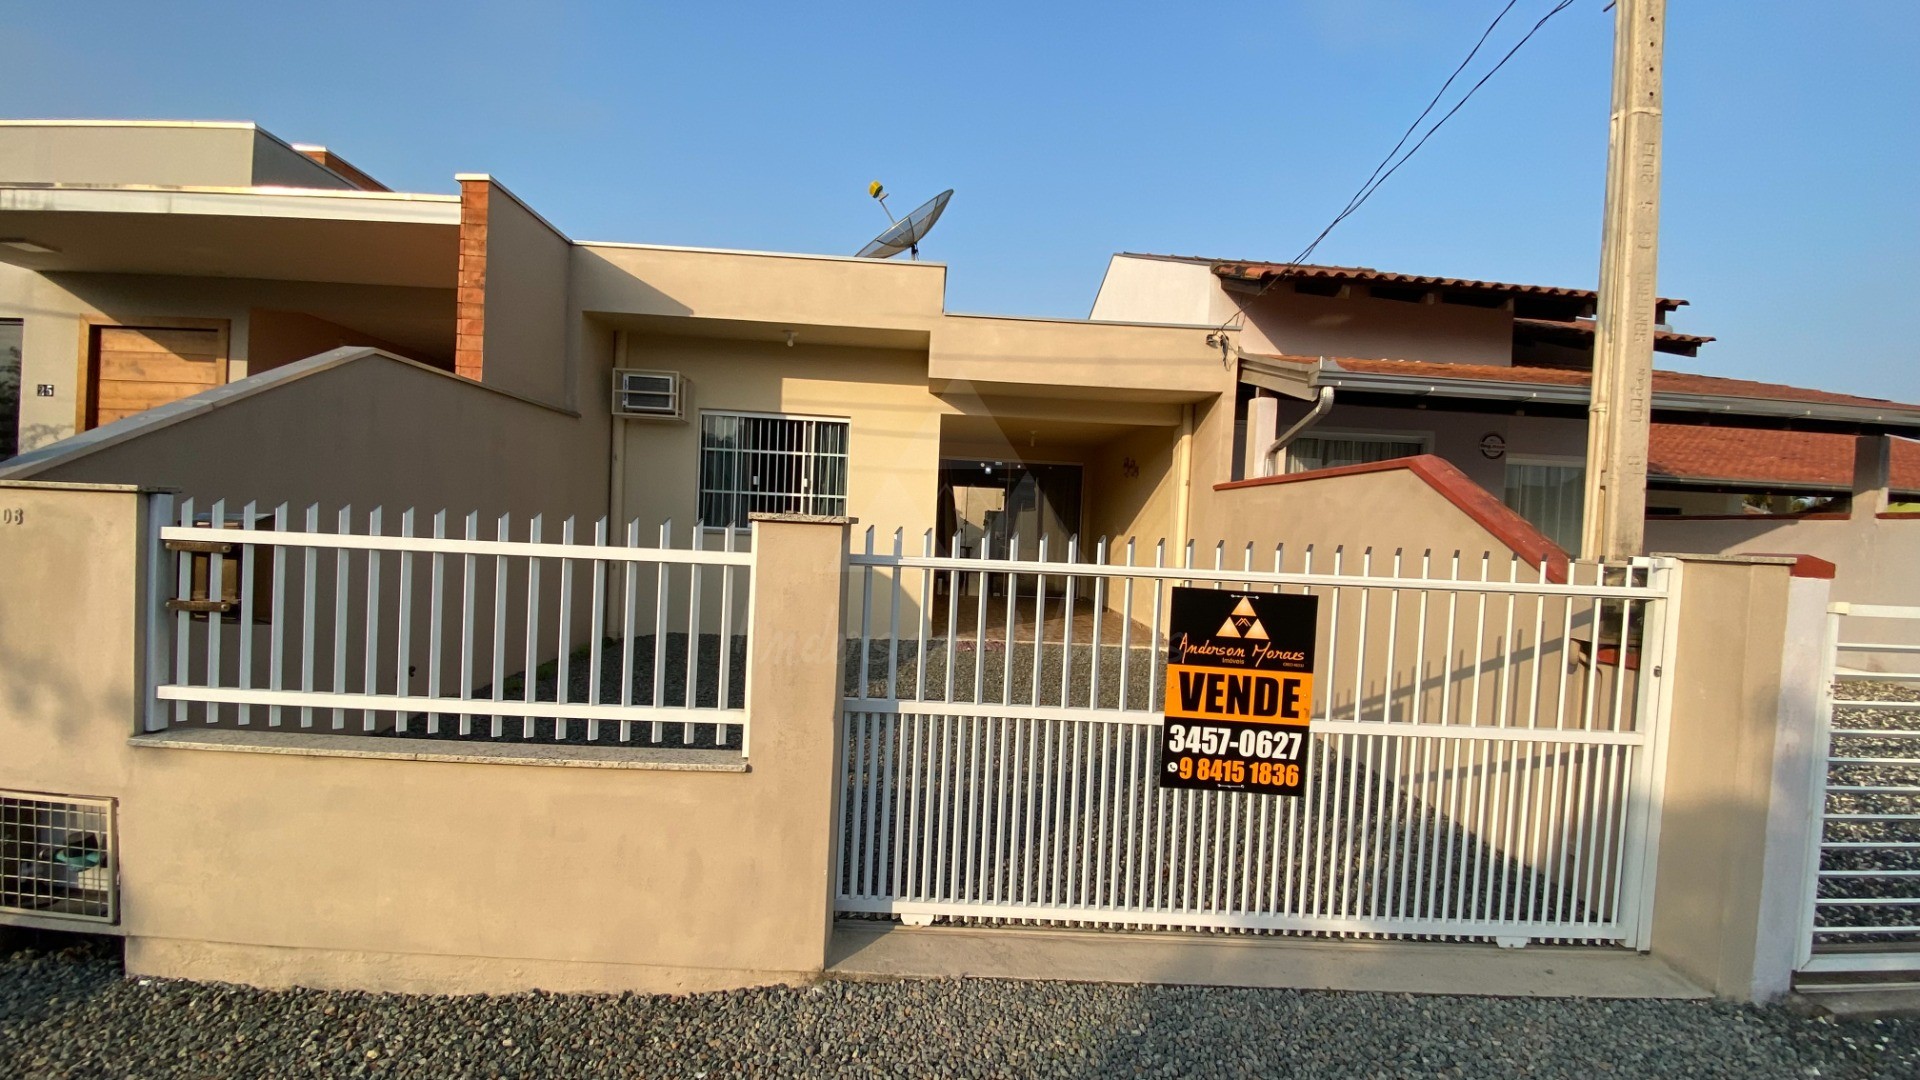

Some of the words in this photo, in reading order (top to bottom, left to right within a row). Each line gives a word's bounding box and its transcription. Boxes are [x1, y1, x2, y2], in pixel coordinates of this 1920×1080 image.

[1179, 632, 1245, 664] Anderson
[1252, 641, 1305, 667] Moraes
[1178, 671, 1301, 719] VENDE
[1168, 724, 1302, 760] 3457-0627
[1179, 756, 1193, 780] 9
[1197, 758, 1245, 783] 8415
[1249, 761, 1299, 787] 1836
